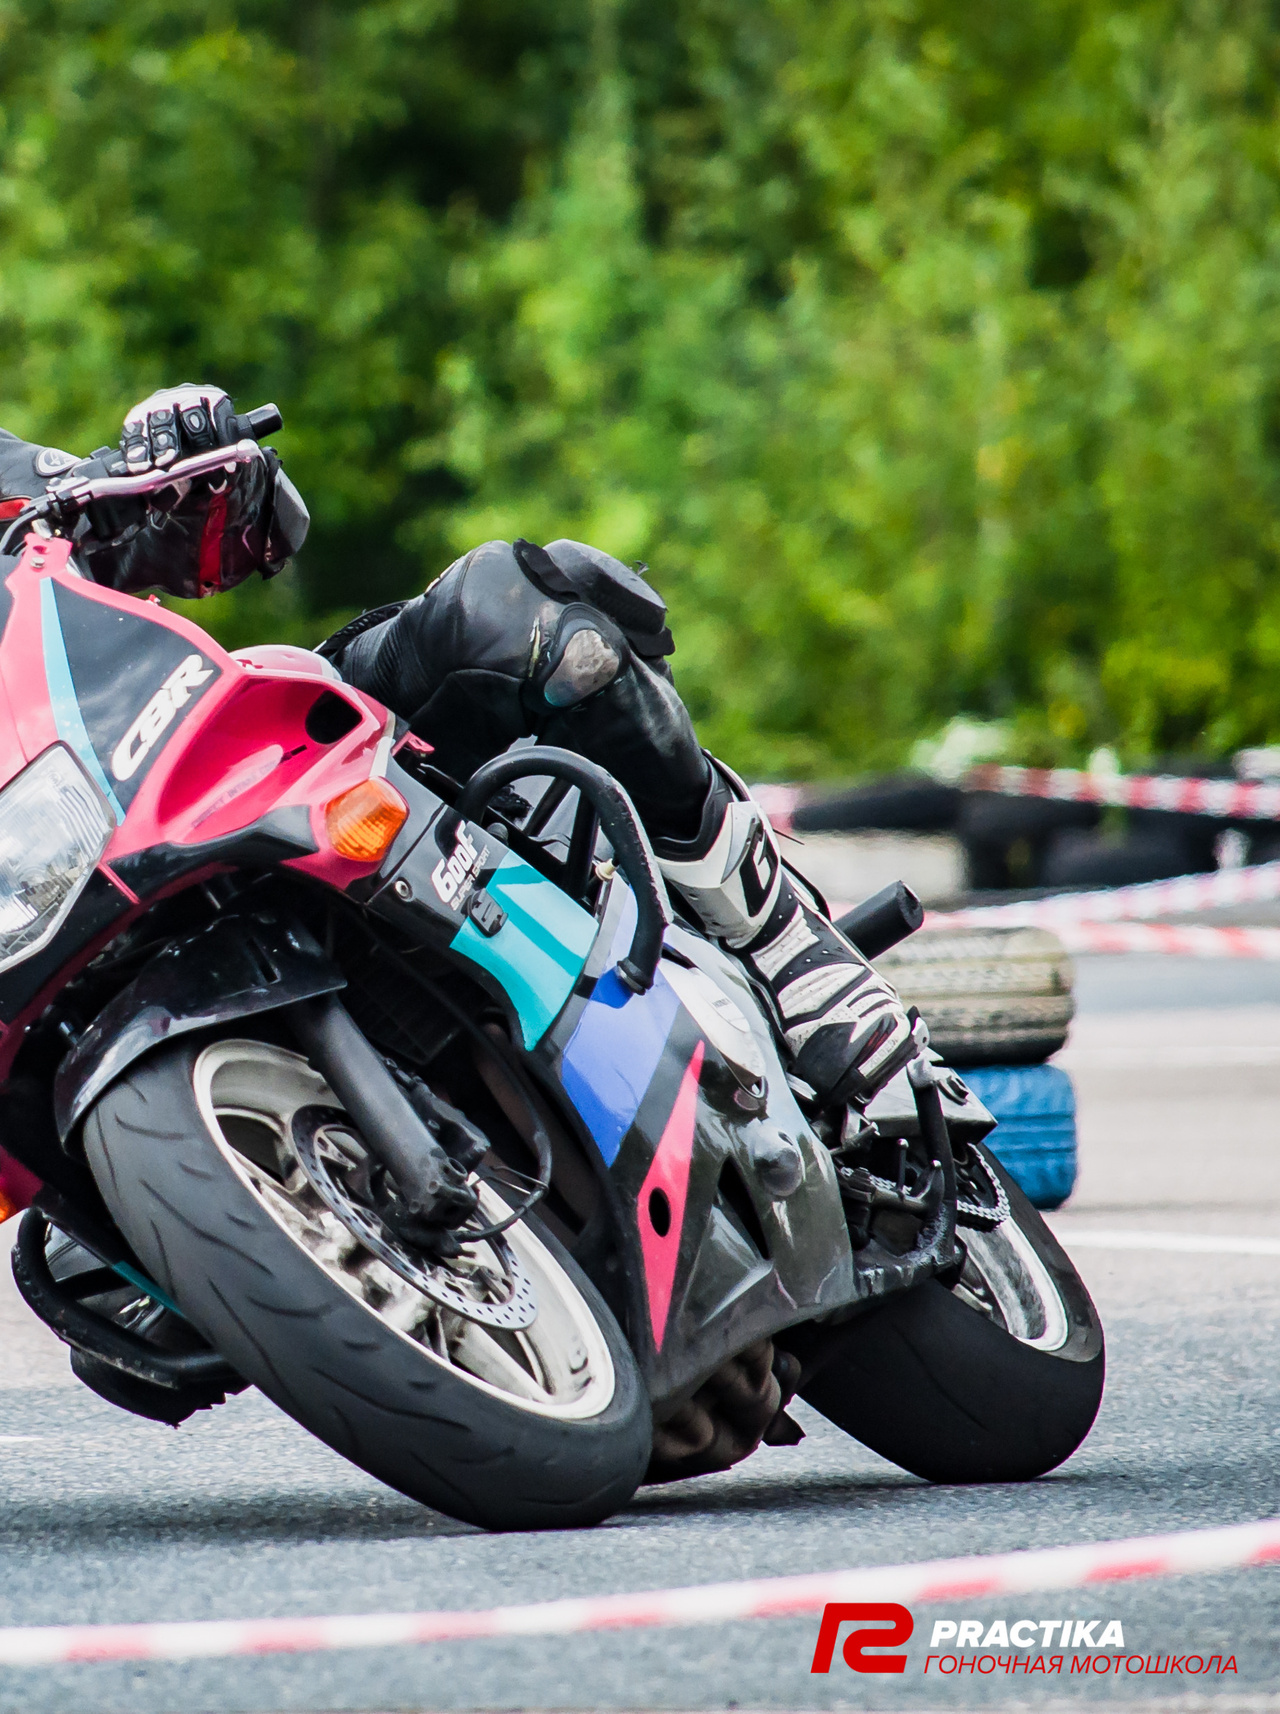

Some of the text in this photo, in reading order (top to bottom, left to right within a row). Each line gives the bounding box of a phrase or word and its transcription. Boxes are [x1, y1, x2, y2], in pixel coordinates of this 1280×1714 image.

[111, 654, 214, 781] CBR
[431, 819, 478, 903] 600F
[450, 844, 491, 911] SUPER SPORT
